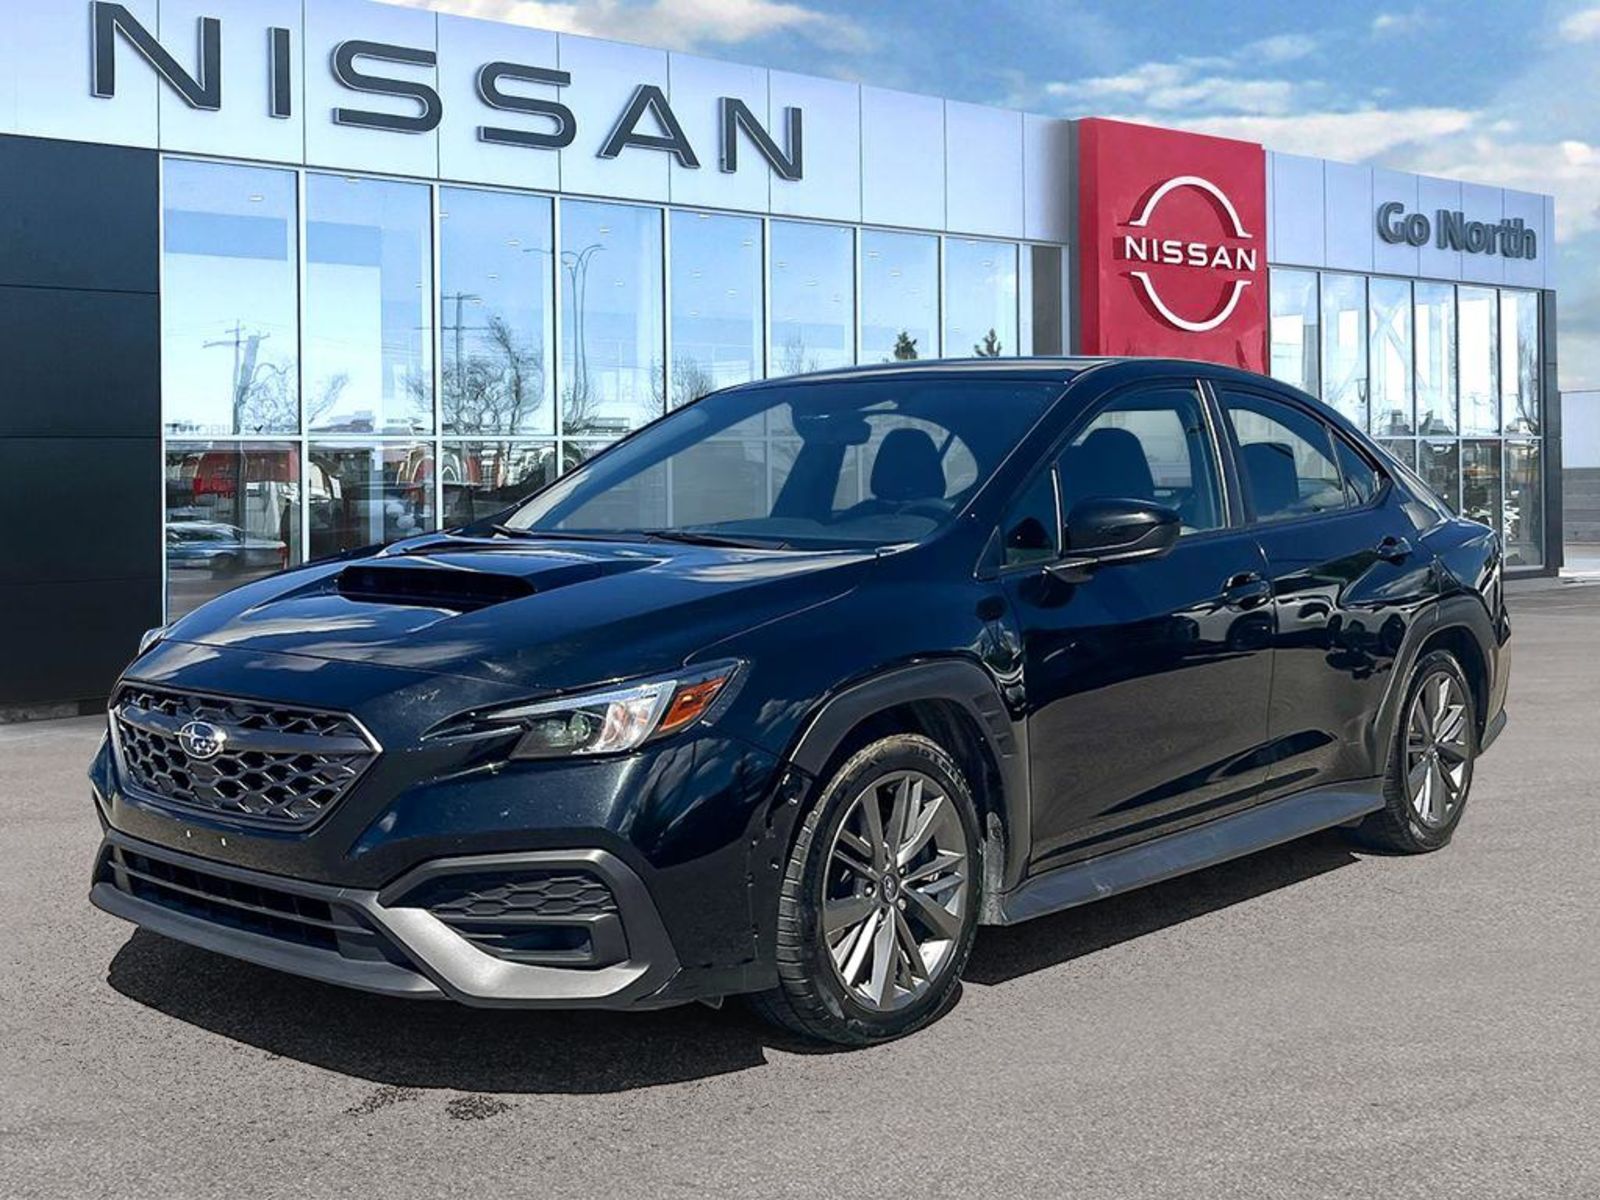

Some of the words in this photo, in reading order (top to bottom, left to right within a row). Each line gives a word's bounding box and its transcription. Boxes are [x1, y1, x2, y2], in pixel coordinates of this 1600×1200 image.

[90, 0, 803, 181] NISSAN
[1124, 235, 1256, 272] NISSAN
[1377, 201, 1430, 246] Go
[1436, 208, 1537, 260] North
